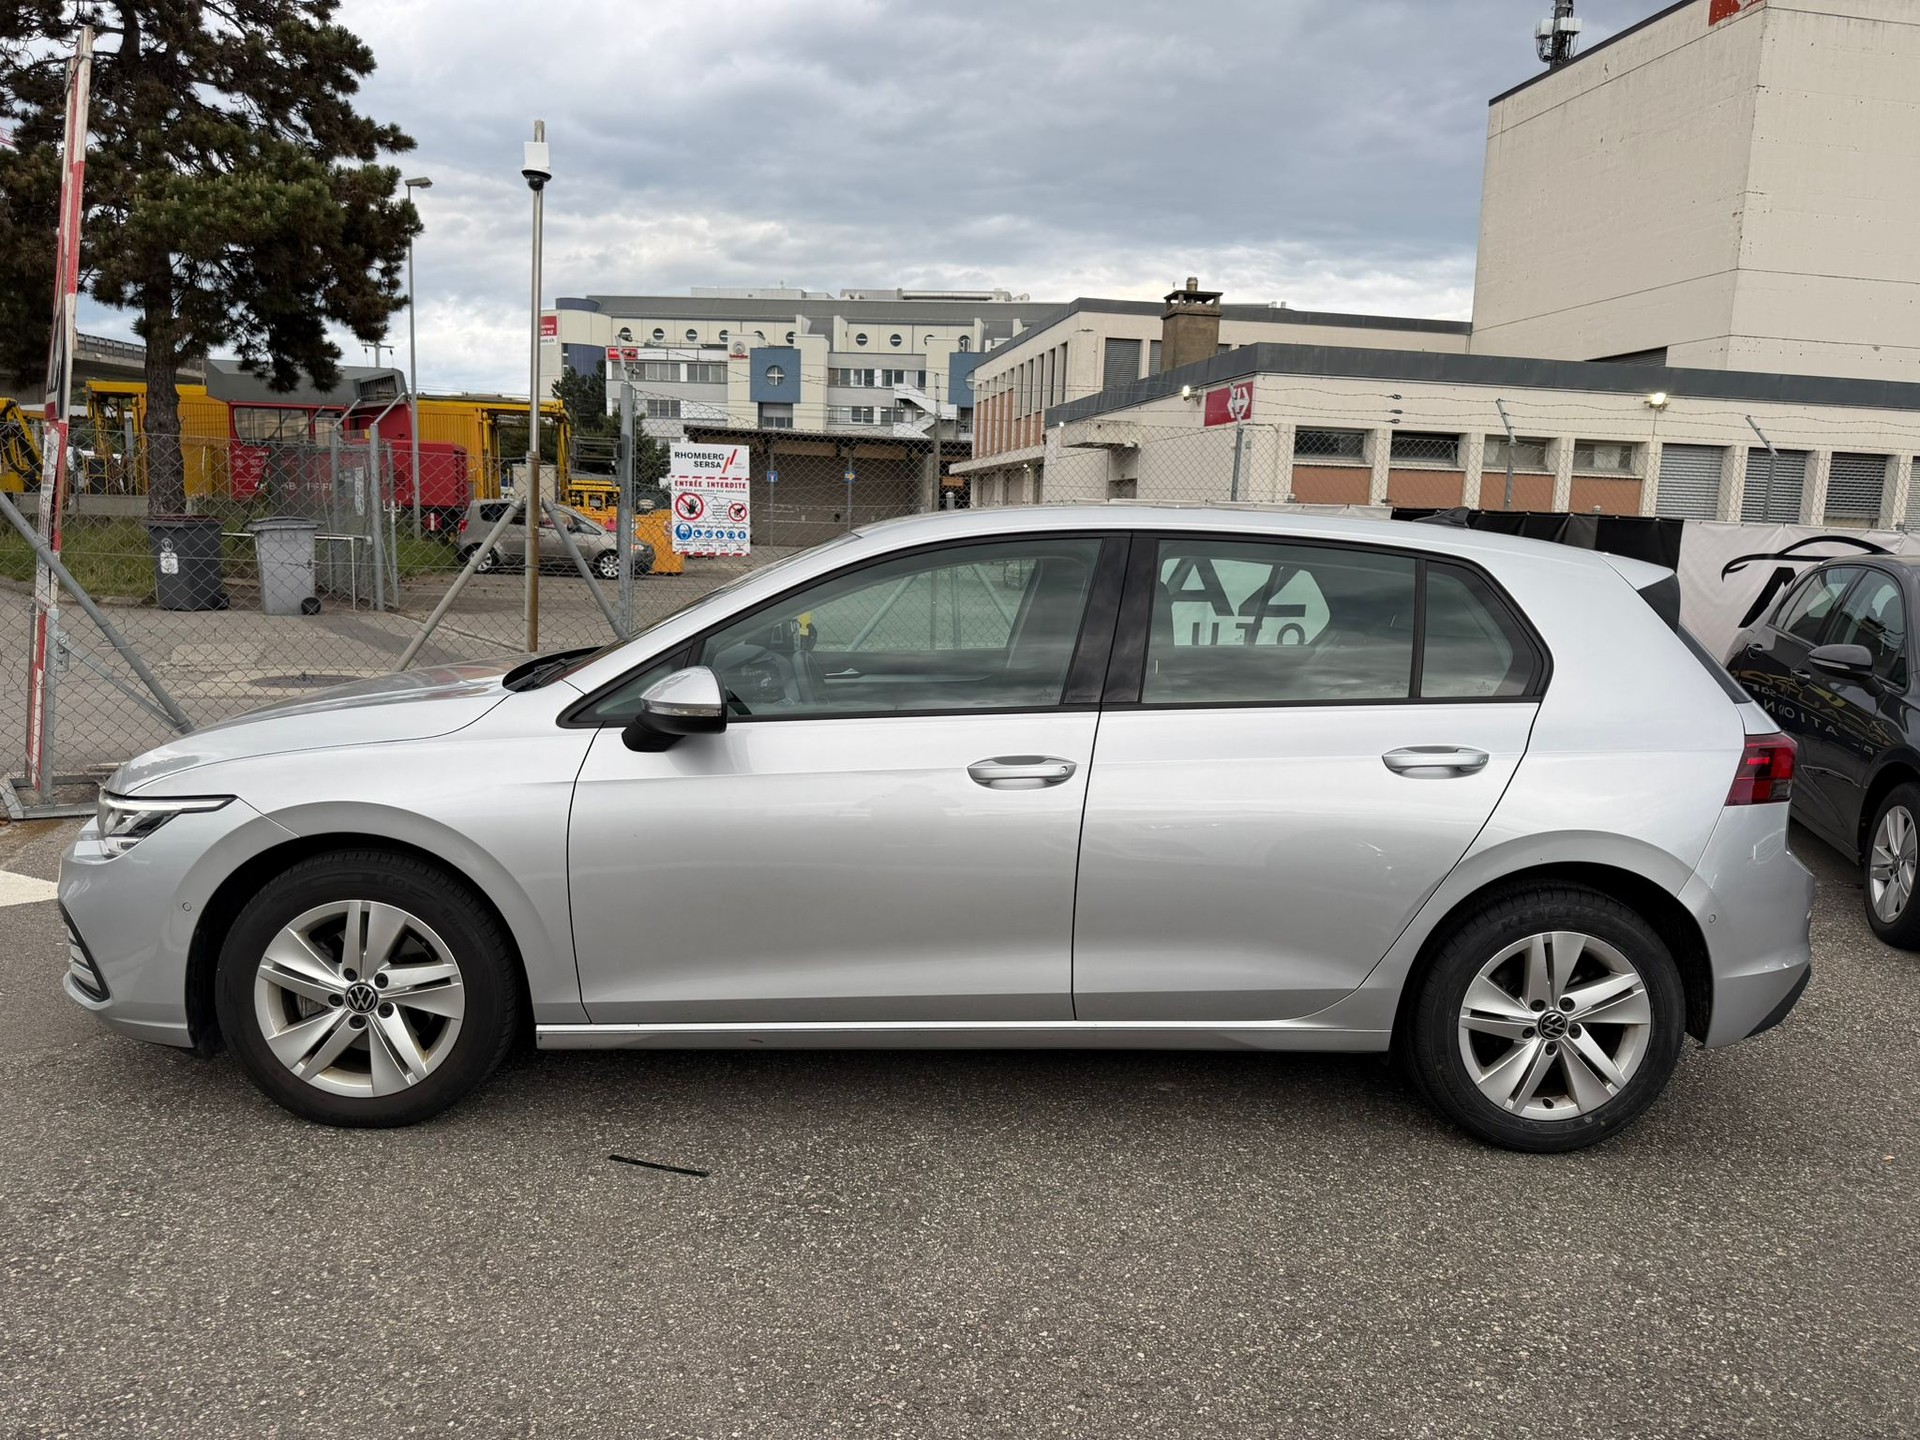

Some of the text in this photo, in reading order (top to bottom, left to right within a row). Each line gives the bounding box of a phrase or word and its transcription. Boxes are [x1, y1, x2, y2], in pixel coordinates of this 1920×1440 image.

[674, 451, 725, 460] RHOMBERG
[693, 461, 722, 469] SERSA
[674, 479, 747, 489] ENTRÉE INTERDITE
